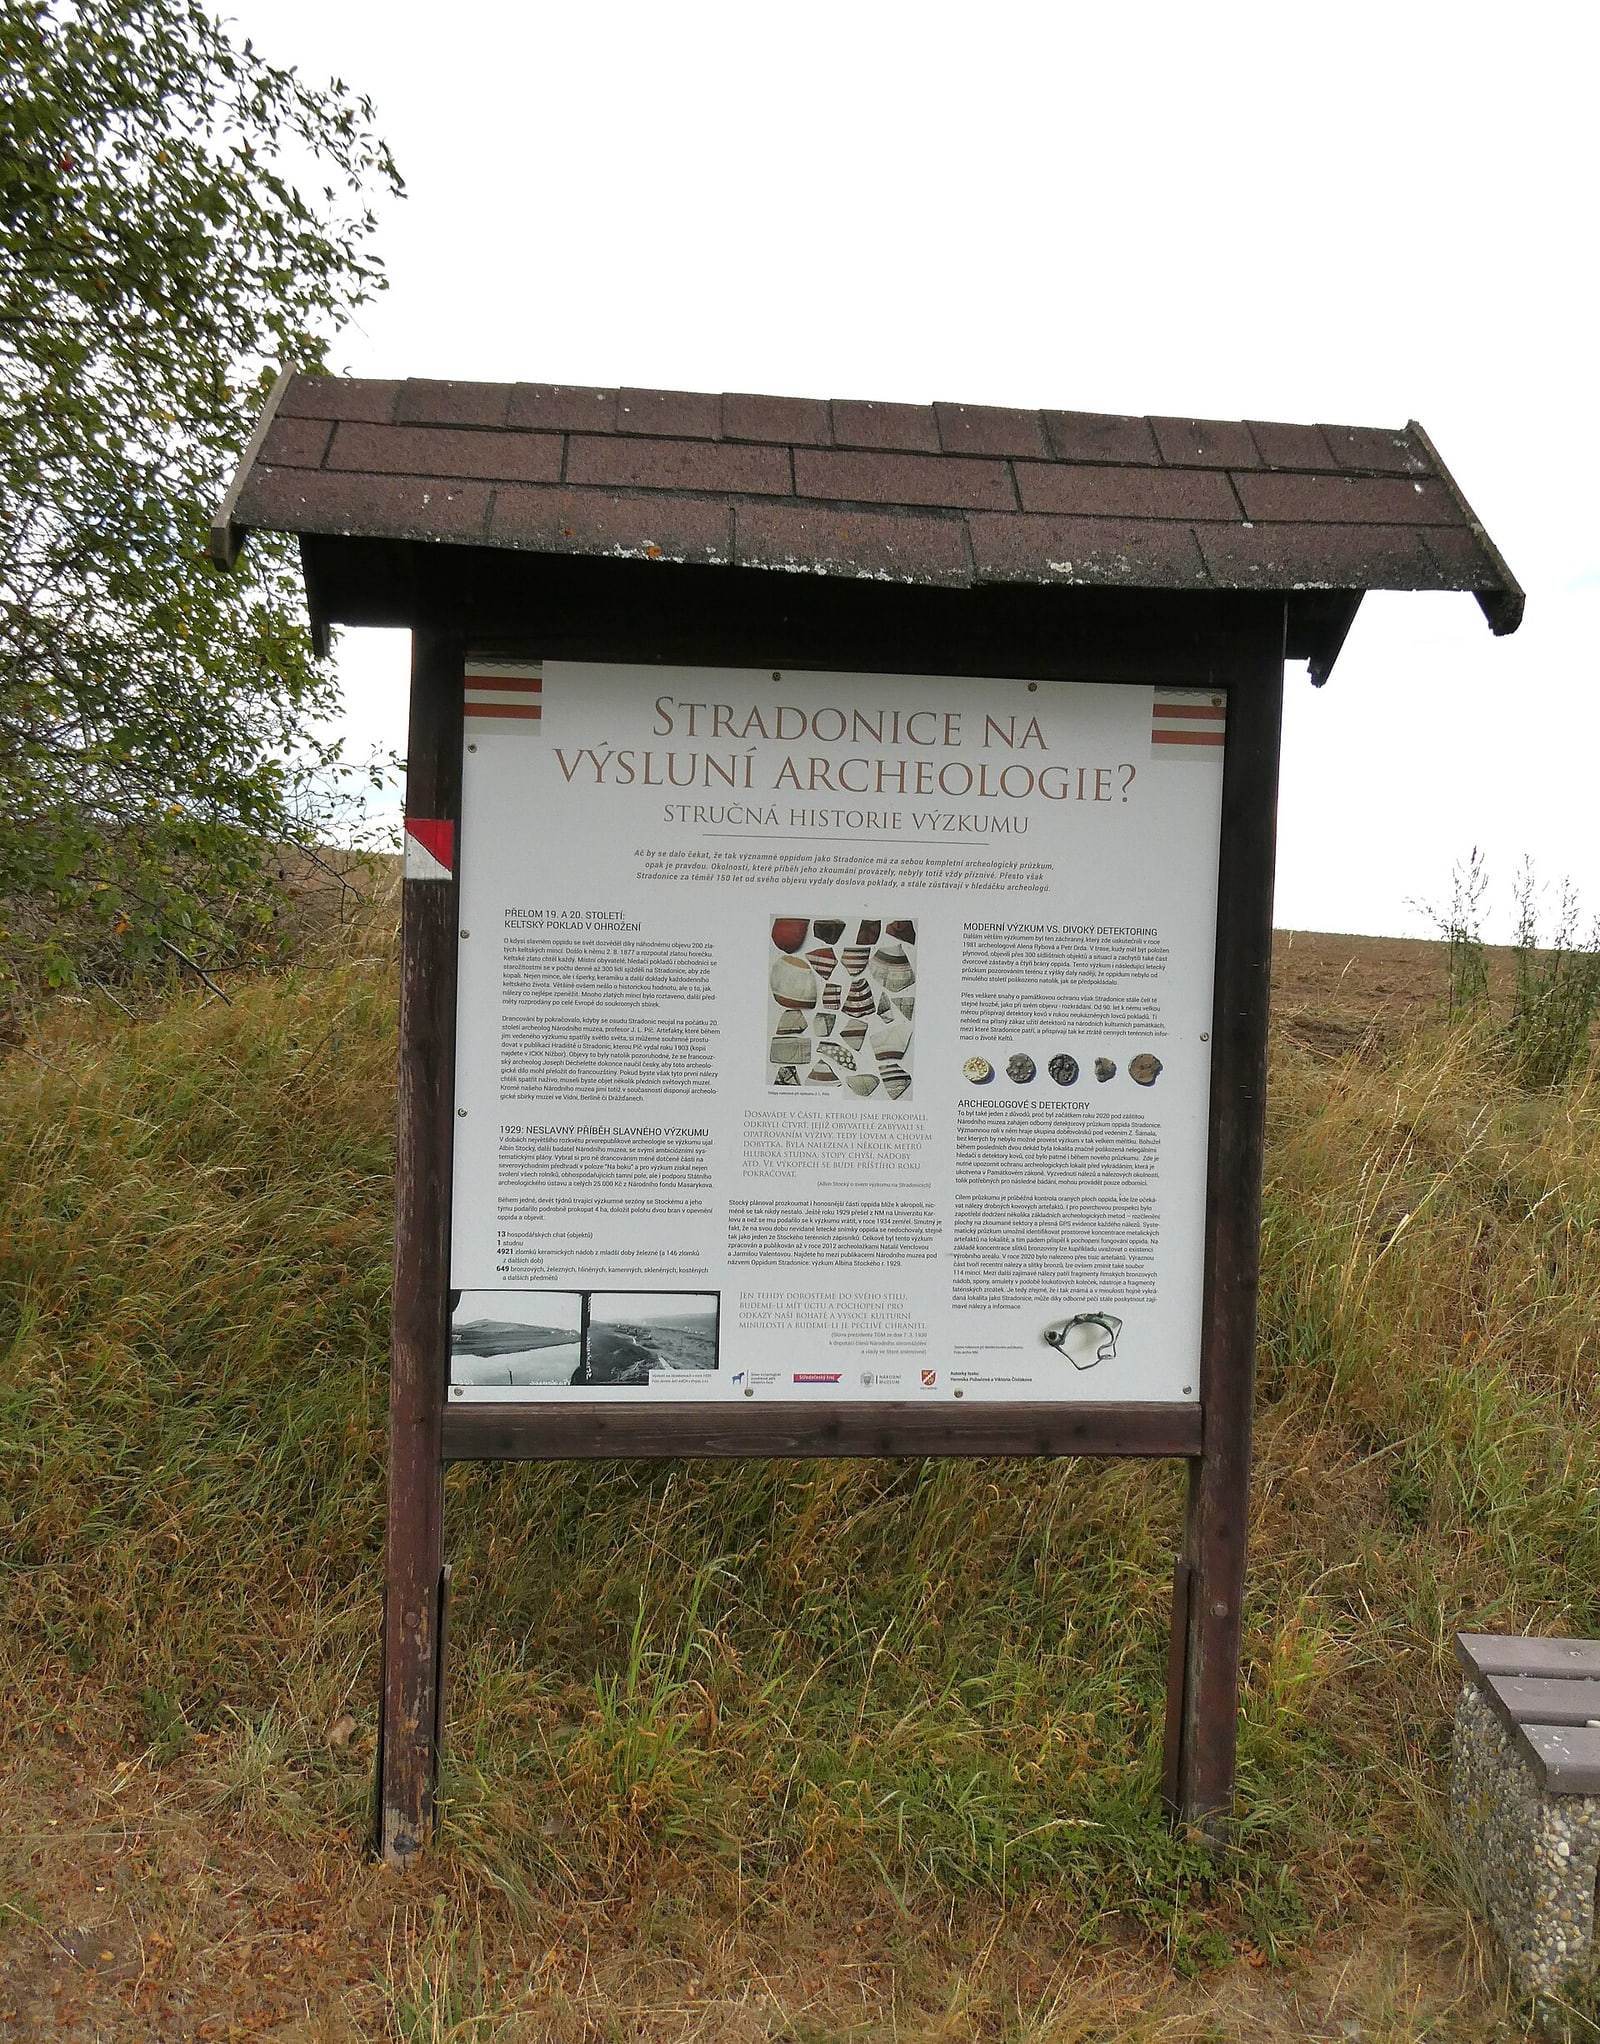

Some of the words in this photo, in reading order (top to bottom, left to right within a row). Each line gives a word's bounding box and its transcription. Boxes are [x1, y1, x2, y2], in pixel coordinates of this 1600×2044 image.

[652, 696, 962, 748] STRADONICE
[983, 713, 1049, 751] NA
[552, 741, 758, 789] VÝSLUNÍ
[772, 756, 1136, 803] ARCHEOLOGIE?
[664, 800, 778, 826] STRUČNÁ
[790, 807, 902, 831] HISTORIE
[912, 808, 1028, 835] VÝZKUMU
[646, 850, 656, 859] by
[669, 850, 686, 858] dalo
[687, 851, 711, 860] čekat,
[713, 851, 723, 859] že
[724, 852, 737, 860] tak
[739, 852, 778, 862] významné
[779, 854, 813, 864] oppidum
[814, 855, 831, 864] jako
[833, 855, 874, 864] Stradonice
[876, 856, 888, 864] má
[900, 857, 924, 865] sebou
[925, 858, 964, 868] kompletní
[965, 859, 1018, 870] archeologický
[1019, 861, 1054, 871] průzkum,
[645, 861, 664, 871] opak
[665, 862, 673, 871] je
[675, 862, 707, 872] pravdou.
[711, 863, 750, 873] Okolnosti,
[752, 864, 772, 872] které
[774, 865, 799, 875] příběh
[800, 866, 818, 875] jeho
[819, 866, 857, 875] zkoumání
[858, 867, 896, 877] provázely,
[898, 869, 924, 878] nebyly
[925, 869, 943, 877] totiž
[945, 870, 963, 879] vždy
[964, 870, 997, 880] příznivé.
[999, 871, 1024, 880] Přesto
[1026, 872, 1044, 880] však
[636, 872, 678, 881] Stradonice
[691, 873, 714, 882] téměř
[732, 875, 743, 883] let
[745, 875, 755, 883] od
[757, 875, 780, 884] svého
[781, 876, 807, 886] objevu
[809, 877, 834, 887] vydaly
[835, 878, 866, 886] doslova
[867, 879, 898, 889] poklady,
[907, 880, 927, 888] stále
[928, 880, 963, 891] zůstávají
[971, 882, 1005, 890] hledáčku
[1007, 883, 1051, 893] archeologů.
[504, 908, 543, 919] PŘELOM
[546, 911, 559, 919] 19.
[561, 911, 568, 919] A
[570, 911, 582, 919] 20.
[585, 910, 625, 920] STOLETÍ:
[504, 919, 544, 930] KELTSKÝ
[546, 922, 584, 930] POKLAD
[586, 922, 592, 931] V
[594, 921, 641, 932] OHROŽENÍ
[963, 922, 1005, 932] MODERNÍ
[1007, 923, 1044, 933] VÝZKUM
[1046, 925, 1059, 934] VS.
[1062, 924, 1095, 935] DIVOKÝ
[1096, 927, 1158, 936] DETEKTORING
[958, 1099, 1029, 1109] ARCHEOLOGOVÉ
[1031, 1101, 1037, 1109] S
[1039, 1101, 1090, 1110] DETEKTORY
[501, 1126, 524, 1134] 1929:
[526, 1125, 575, 1135] NESLAVNÝ
[576, 1126, 611, 1135] PŘÍBĚH
[613, 1126, 662, 1136] SLAVNÉHO
[664, 1127, 709, 1136] VÝZKUMU
